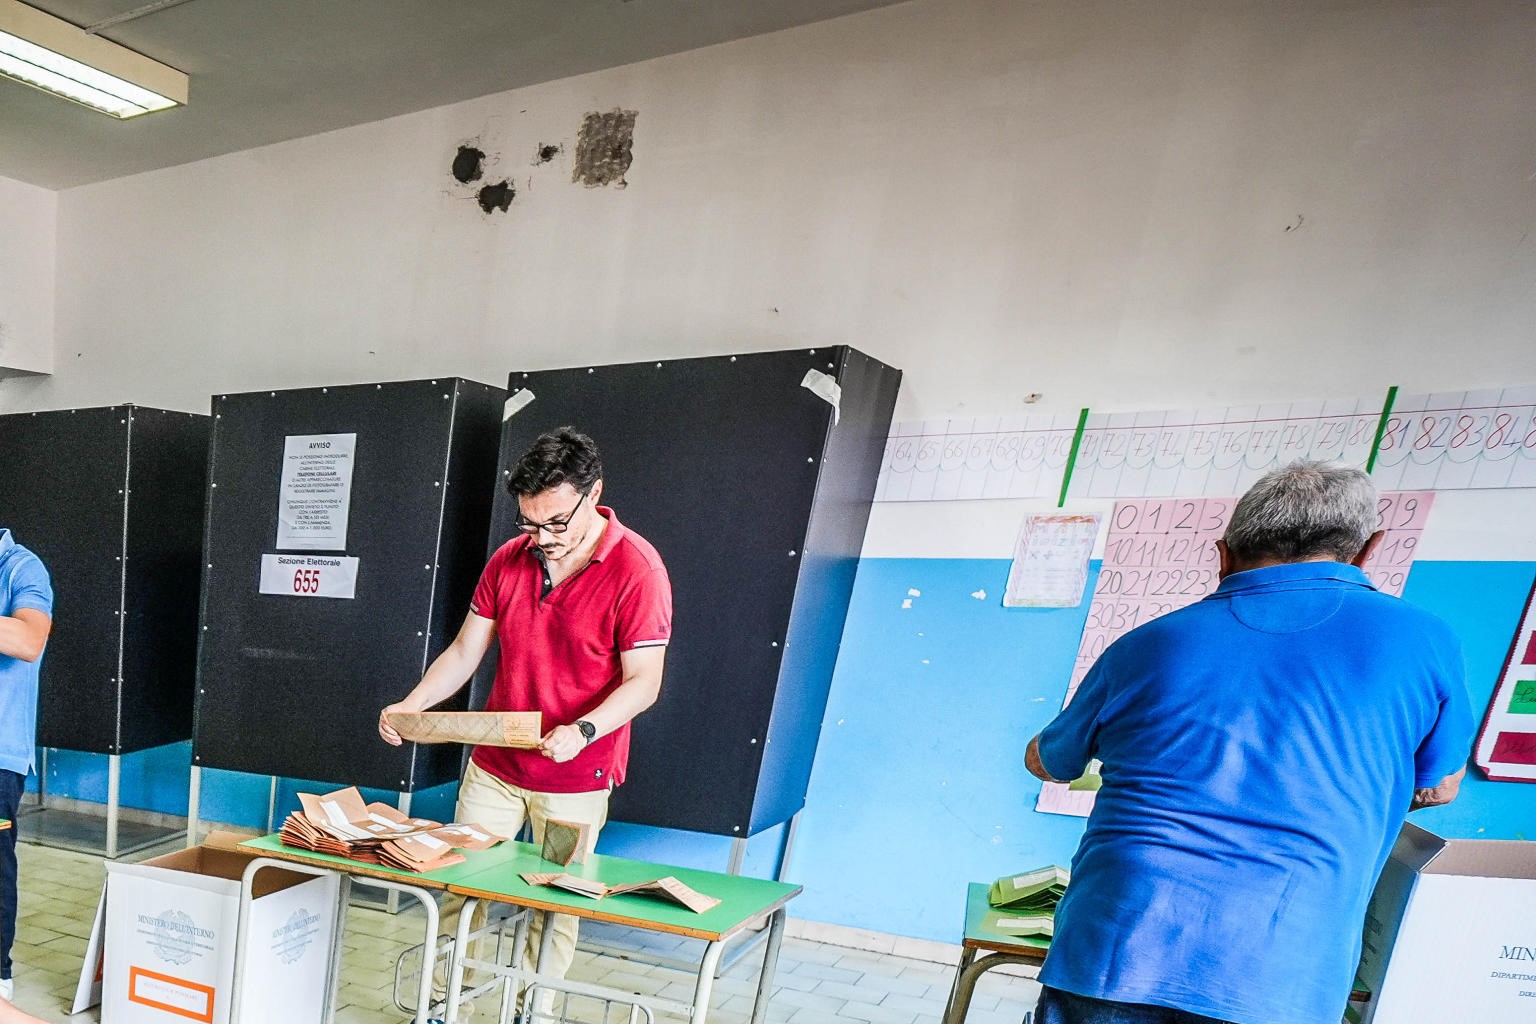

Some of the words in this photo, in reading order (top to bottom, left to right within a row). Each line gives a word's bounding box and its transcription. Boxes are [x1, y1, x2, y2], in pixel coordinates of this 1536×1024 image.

[308, 441, 331, 450] AVVISO
[1102, 431, 1128, 457] 72
[1133, 431, 1156, 456] 73
[1162, 431, 1184, 455] 74
[1192, 430, 1216, 456] 75
[1222, 430, 1243, 454] 76
[1251, 429, 1278, 450] 77
[1284, 423, 1308, 451] 78
[1318, 421, 1345, 450] 79
[1378, 417, 1411, 451] 81
[1413, 416, 1453, 452] 82
[1450, 415, 1490, 450] 83
[1486, 413, 1522, 450] 84
[895, 442, 913, 461] 64
[944, 438, 965, 460] 66
[1022, 435, 1046, 460] 69
[1116, 504, 1138, 530] 0
[1148, 503, 1163, 529] 1
[1174, 502, 1196, 529] 2
[1202, 502, 1227, 531] 3
[1399, 498, 1418, 527] 9
[277, 556, 305, 566] Sezione
[307, 557, 341, 567] Elettorale
[1106, 537, 1134, 566] 10
[1135, 540, 1158, 567] 11
[1164, 538, 1190, 563] 12
[1383, 536, 1418, 566] 19
[293, 569, 320, 594] 655
[1095, 569, 1123, 595] 20
[1121, 569, 1152, 597] 21
[1151, 569, 1183, 596] 22
[1178, 569, 1213, 596] 23
[1085, 601, 1115, 630] 30
[1109, 603, 1140, 630] 31
[138, 913, 170, 930] MINISTERO
[169, 921, 215, 940] DELL'INTERNO
